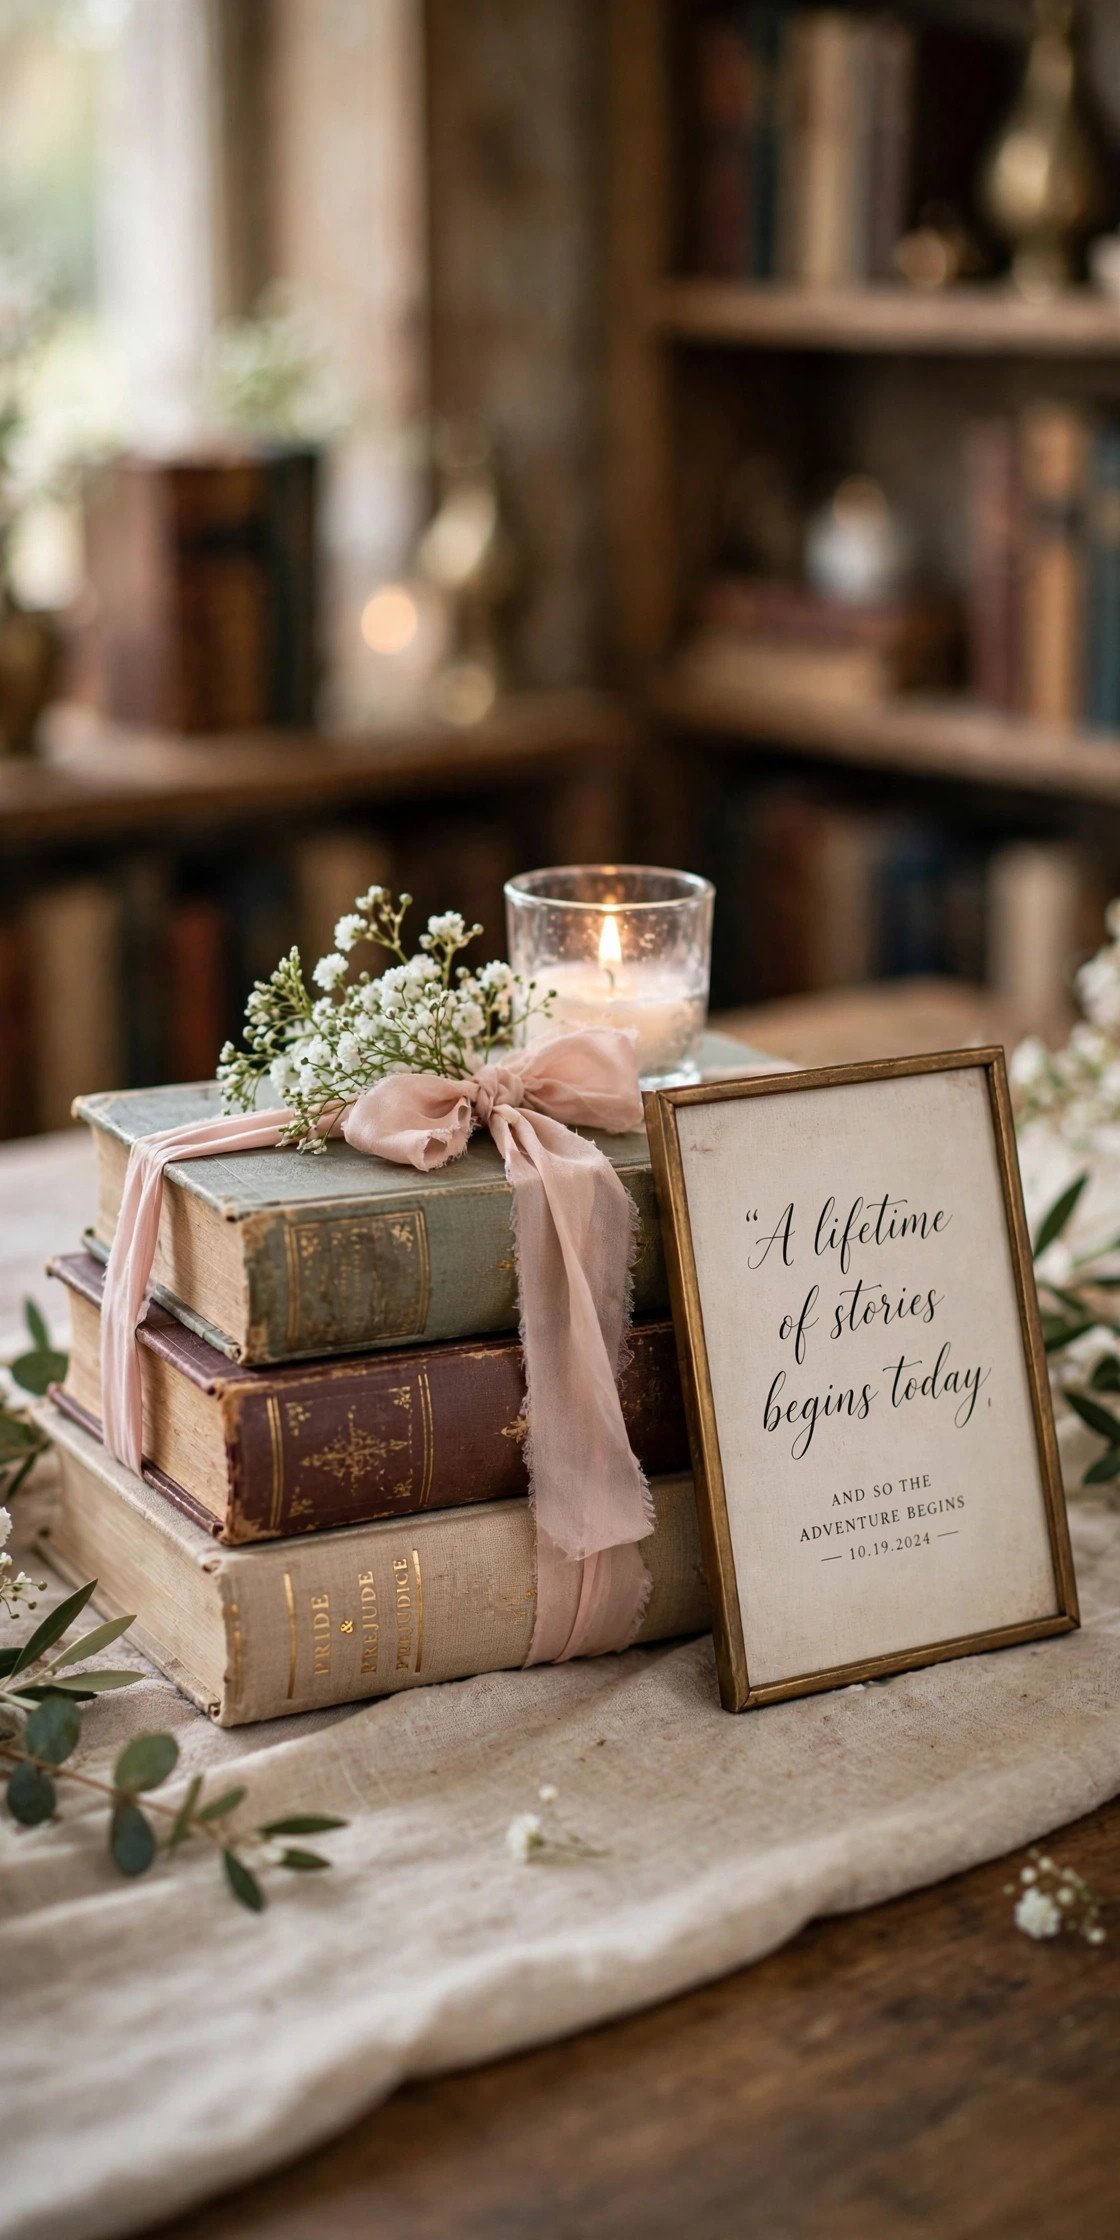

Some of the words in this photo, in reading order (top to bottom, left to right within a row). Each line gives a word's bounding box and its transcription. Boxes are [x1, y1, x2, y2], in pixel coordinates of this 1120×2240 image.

[813, 1193, 953, 1275] lifetime
[778, 1284, 820, 1365] of
[829, 1279, 945, 1340] stories
[762, 1370, 879, 1460] begins
[799, 1509, 901, 1542] ADVENTURE
[907, 1495, 966, 1519] BEGINS
[831, 1487, 866, 1507] AND
[873, 1482, 893, 1498] SO
[899, 1474, 932, 1492] THE
[849, 1532, 931, 1560] 10.19.2024
[311, 1594, 331, 1675] PRIDE
[340, 1620, 354, 1634] &
[358, 1571, 379, 1674] PREJUDE
[392, 1558, 414, 1671] PREJUDICE
